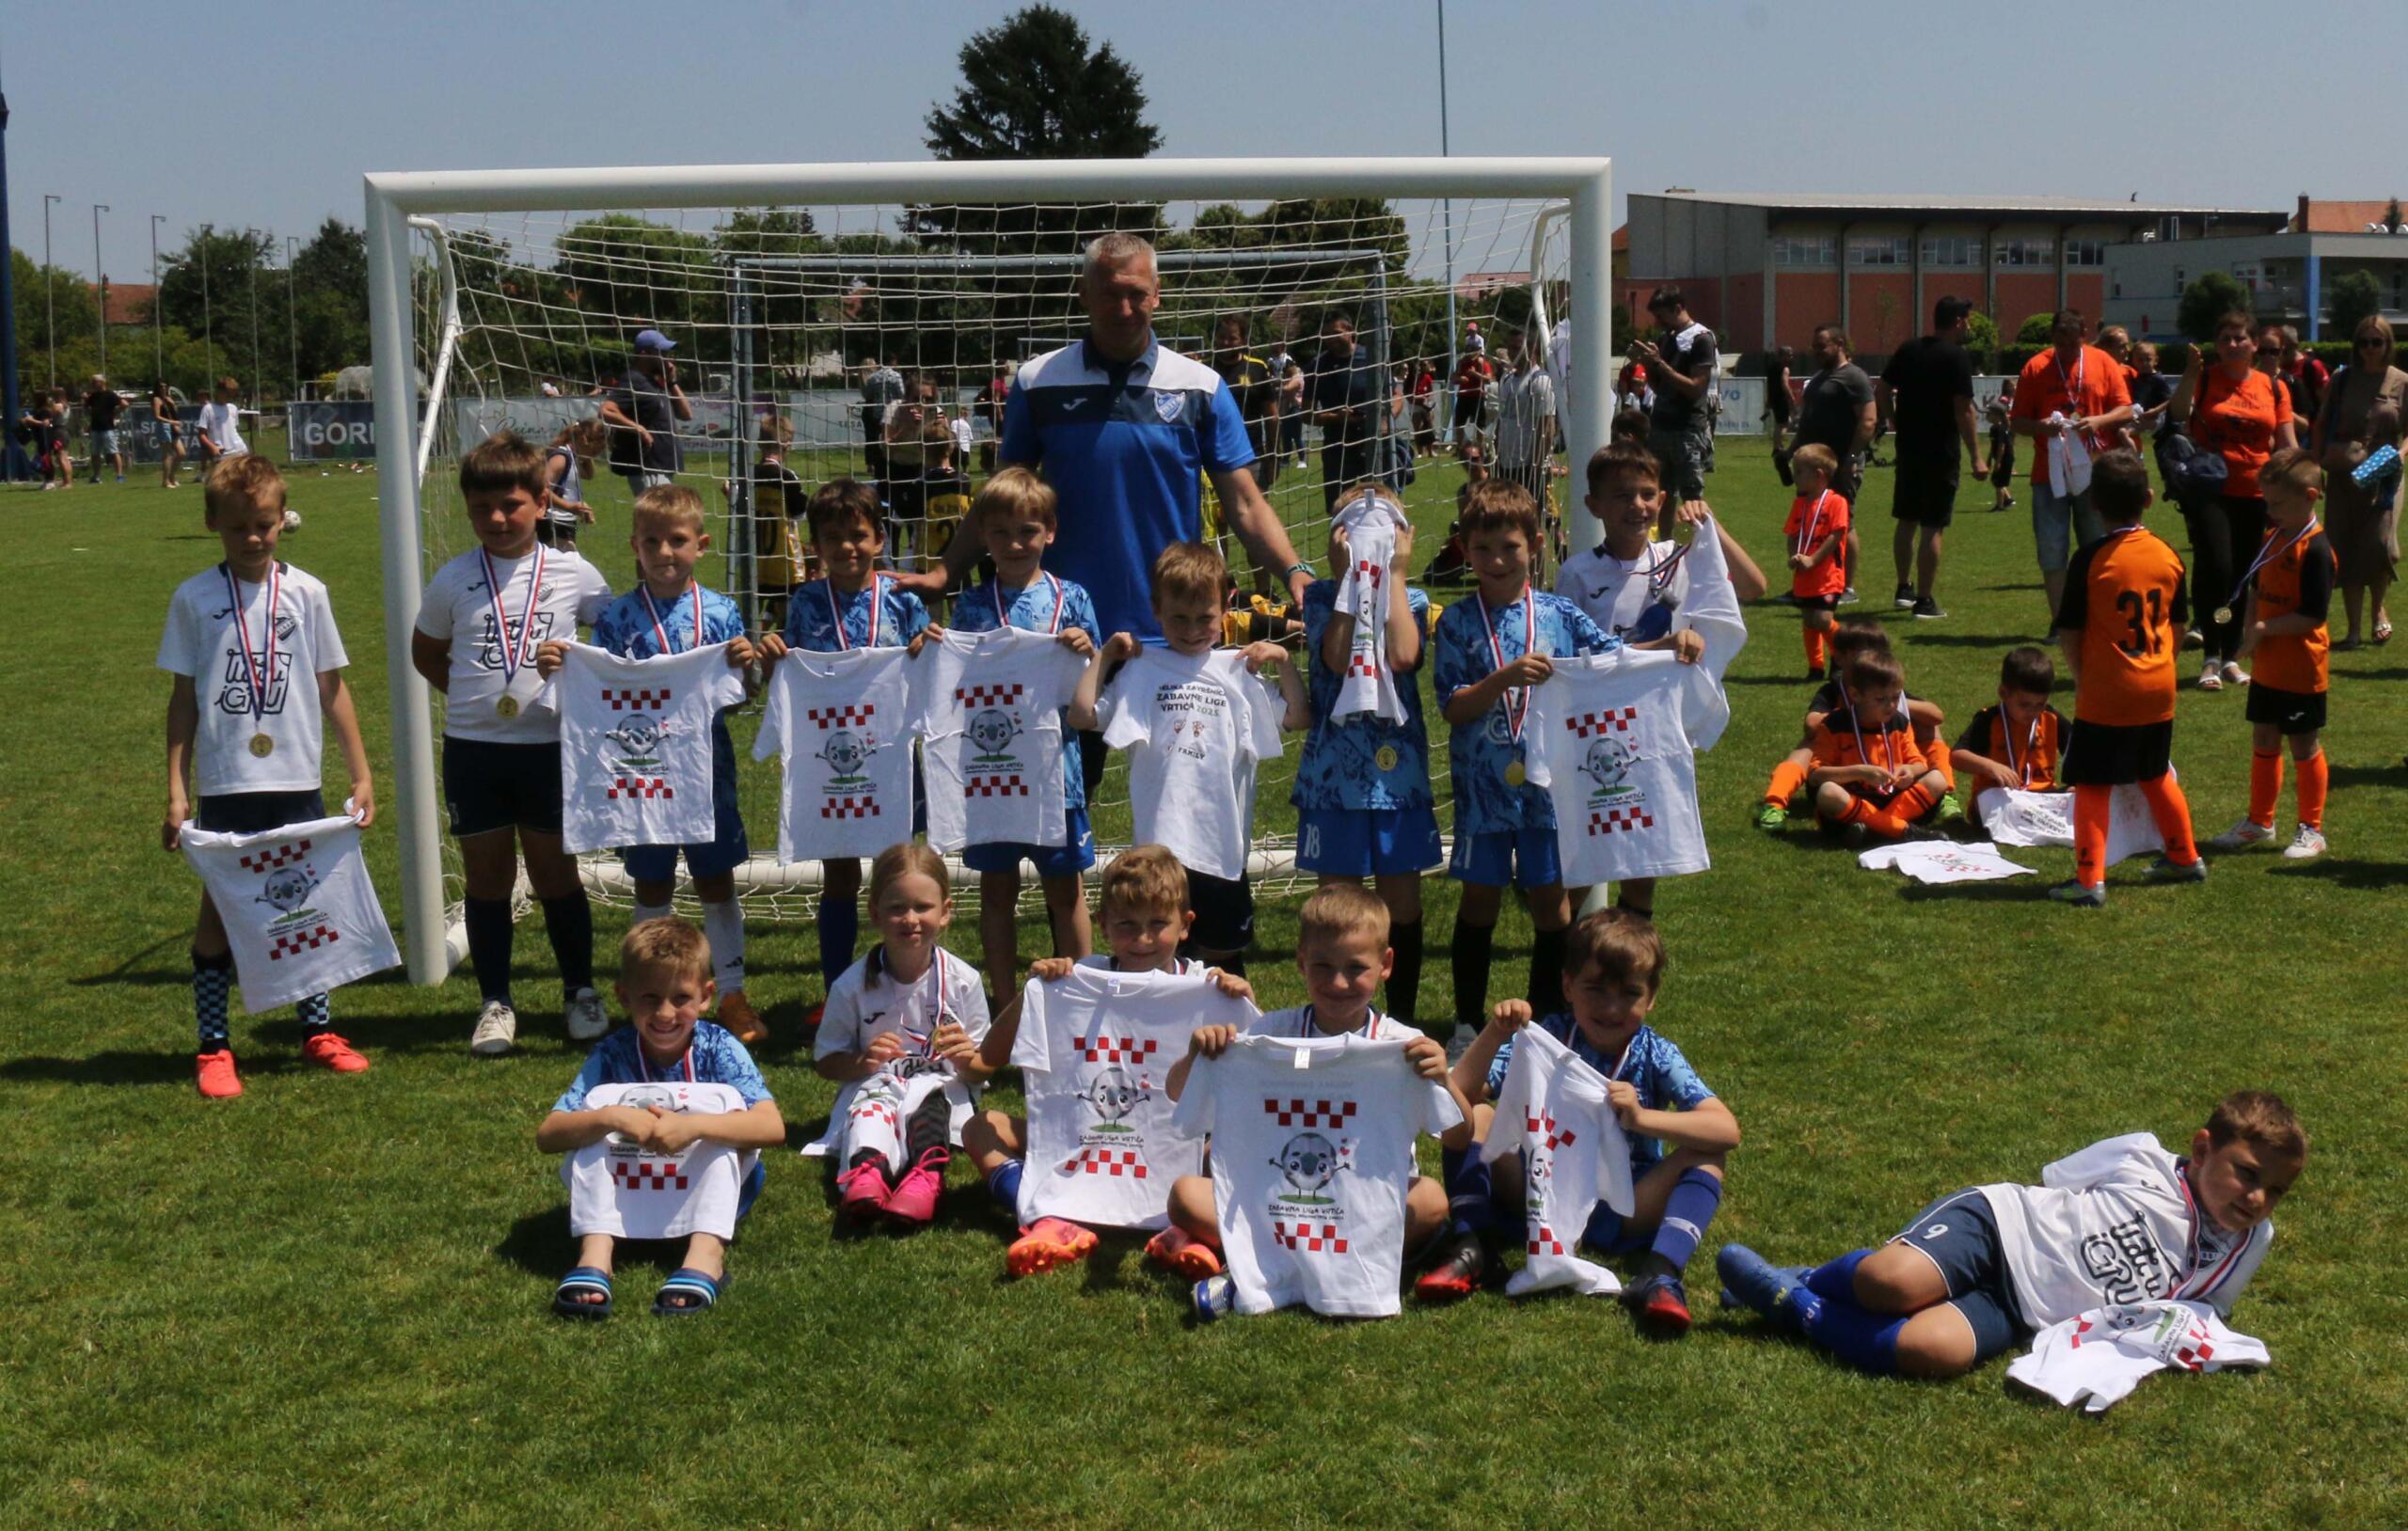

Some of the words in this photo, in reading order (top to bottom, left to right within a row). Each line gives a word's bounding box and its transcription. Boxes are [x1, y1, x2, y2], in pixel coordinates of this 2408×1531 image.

[2116, 588, 2162, 657] 31
[1186, 686, 1226, 696] ZAVRŠNIC
[1157, 693, 1203, 702] ZABAVNE
[1205, 698, 1227, 707] LIGE
[1304, 822, 1321, 859] 18
[1303, 1206, 1319, 1214] LIGA
[1922, 1223, 1949, 1239] 9
